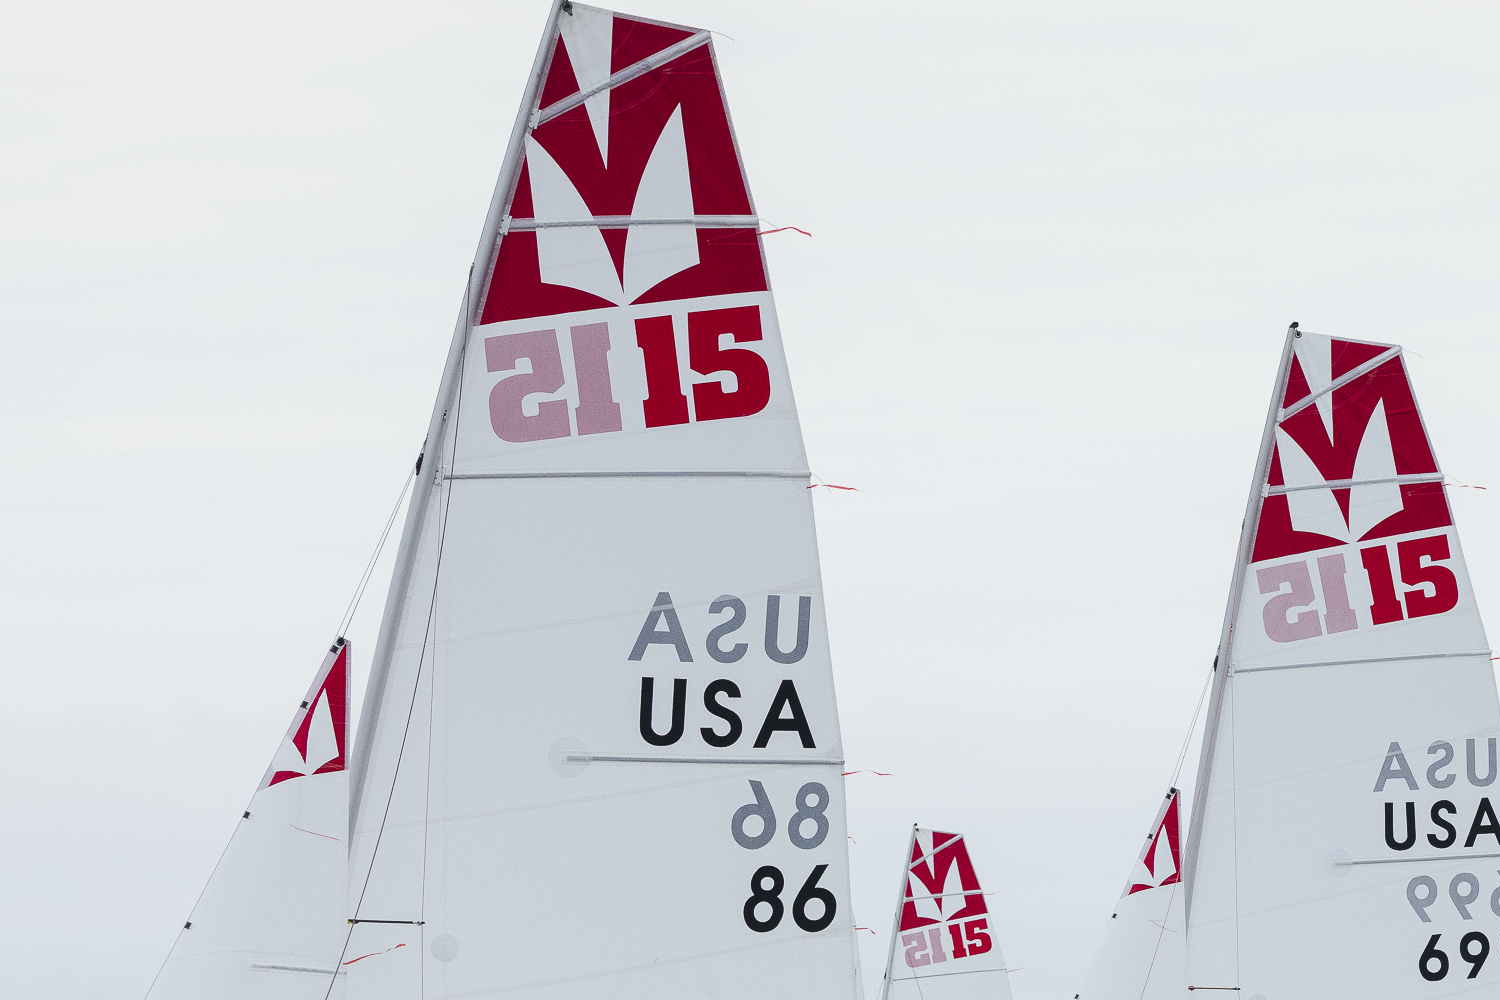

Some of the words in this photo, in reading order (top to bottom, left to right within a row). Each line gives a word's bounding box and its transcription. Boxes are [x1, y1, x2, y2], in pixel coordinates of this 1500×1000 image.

[634, 305, 770, 428] 15
[1360, 534, 1459, 625] 15
[639, 677, 816, 748] USA
[743, 864, 837, 933] 86
[948, 918, 992, 959] 15
